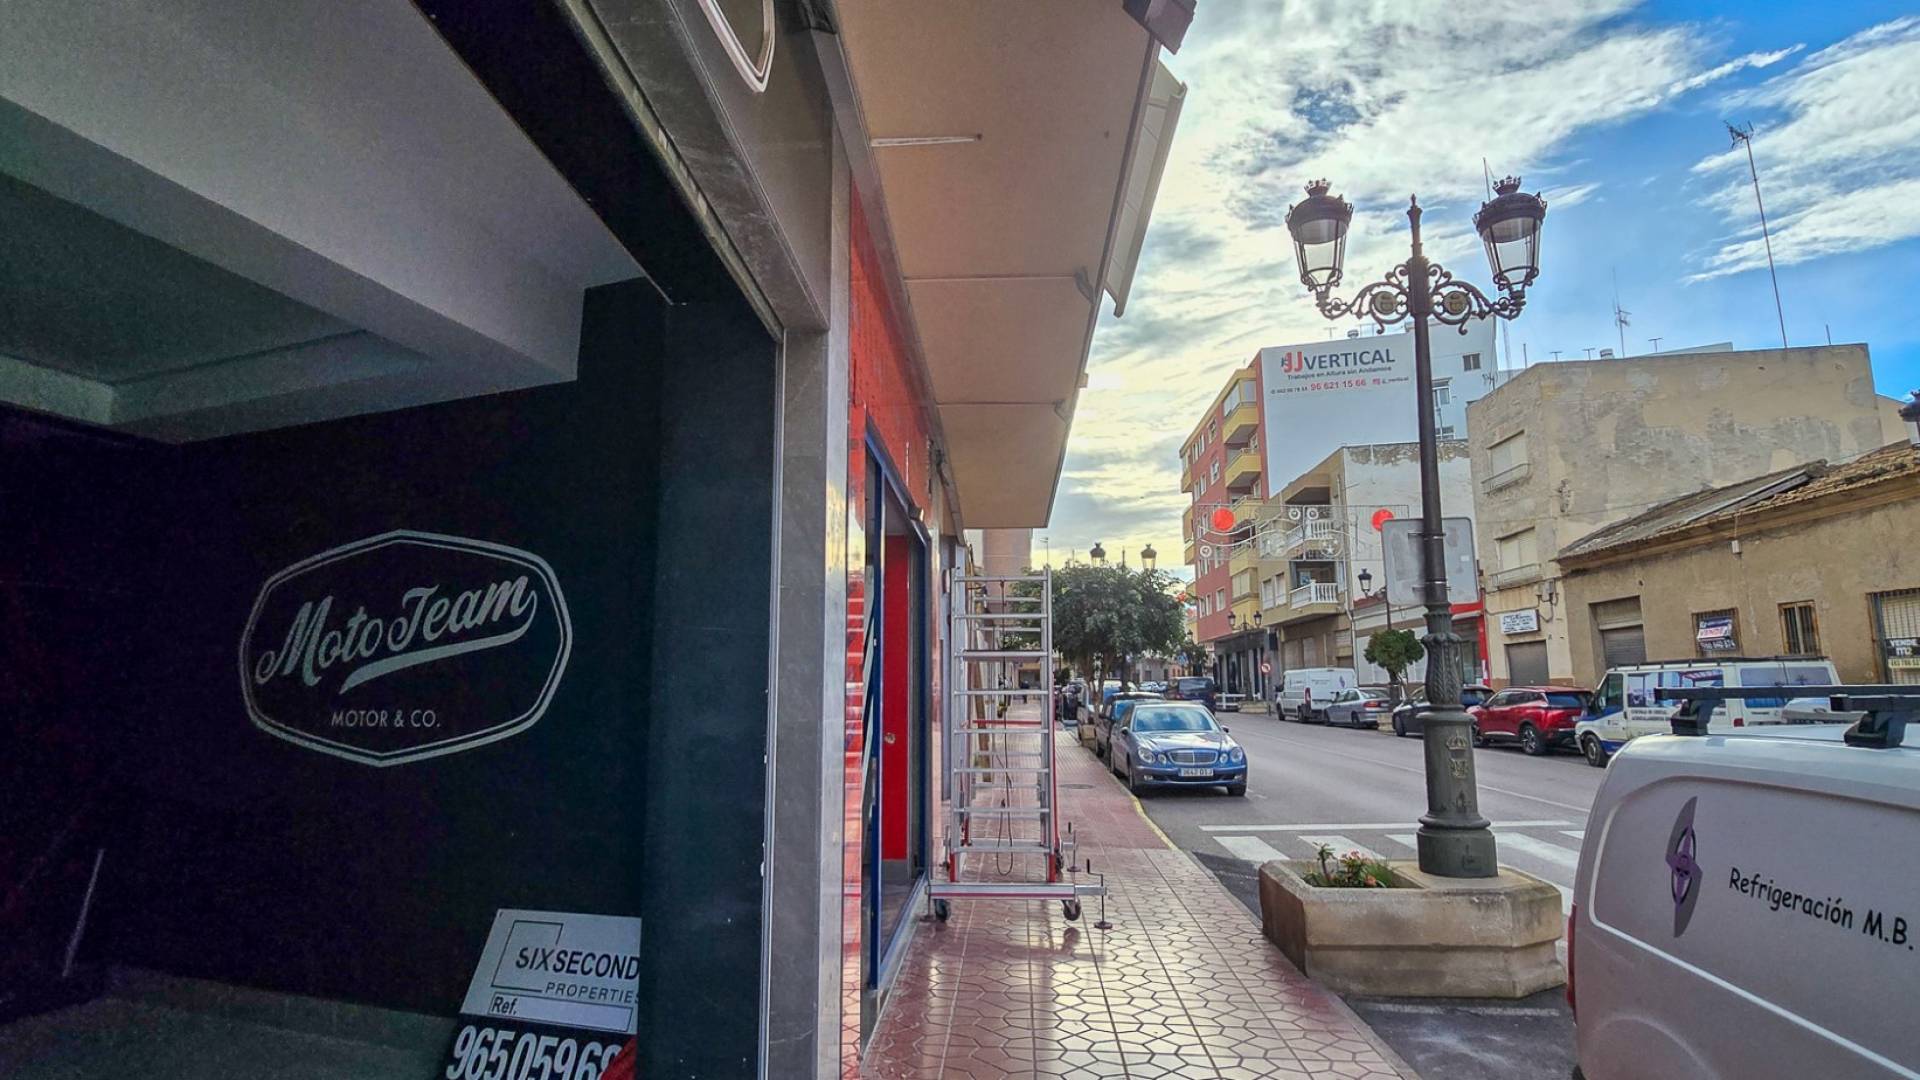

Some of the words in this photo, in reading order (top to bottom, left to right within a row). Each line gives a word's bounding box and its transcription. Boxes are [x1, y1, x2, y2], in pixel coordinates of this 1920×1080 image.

[1323, 381, 1339, 390] 621
[331, 709, 388, 728] MOTOR
[393, 710, 405, 727] &
[411, 709, 441, 728] CO.
[1729, 867, 1854, 930] Refrigeración
[1862, 909, 1915, 951] M.B.
[491, 996, 518, 1015] Ref.
